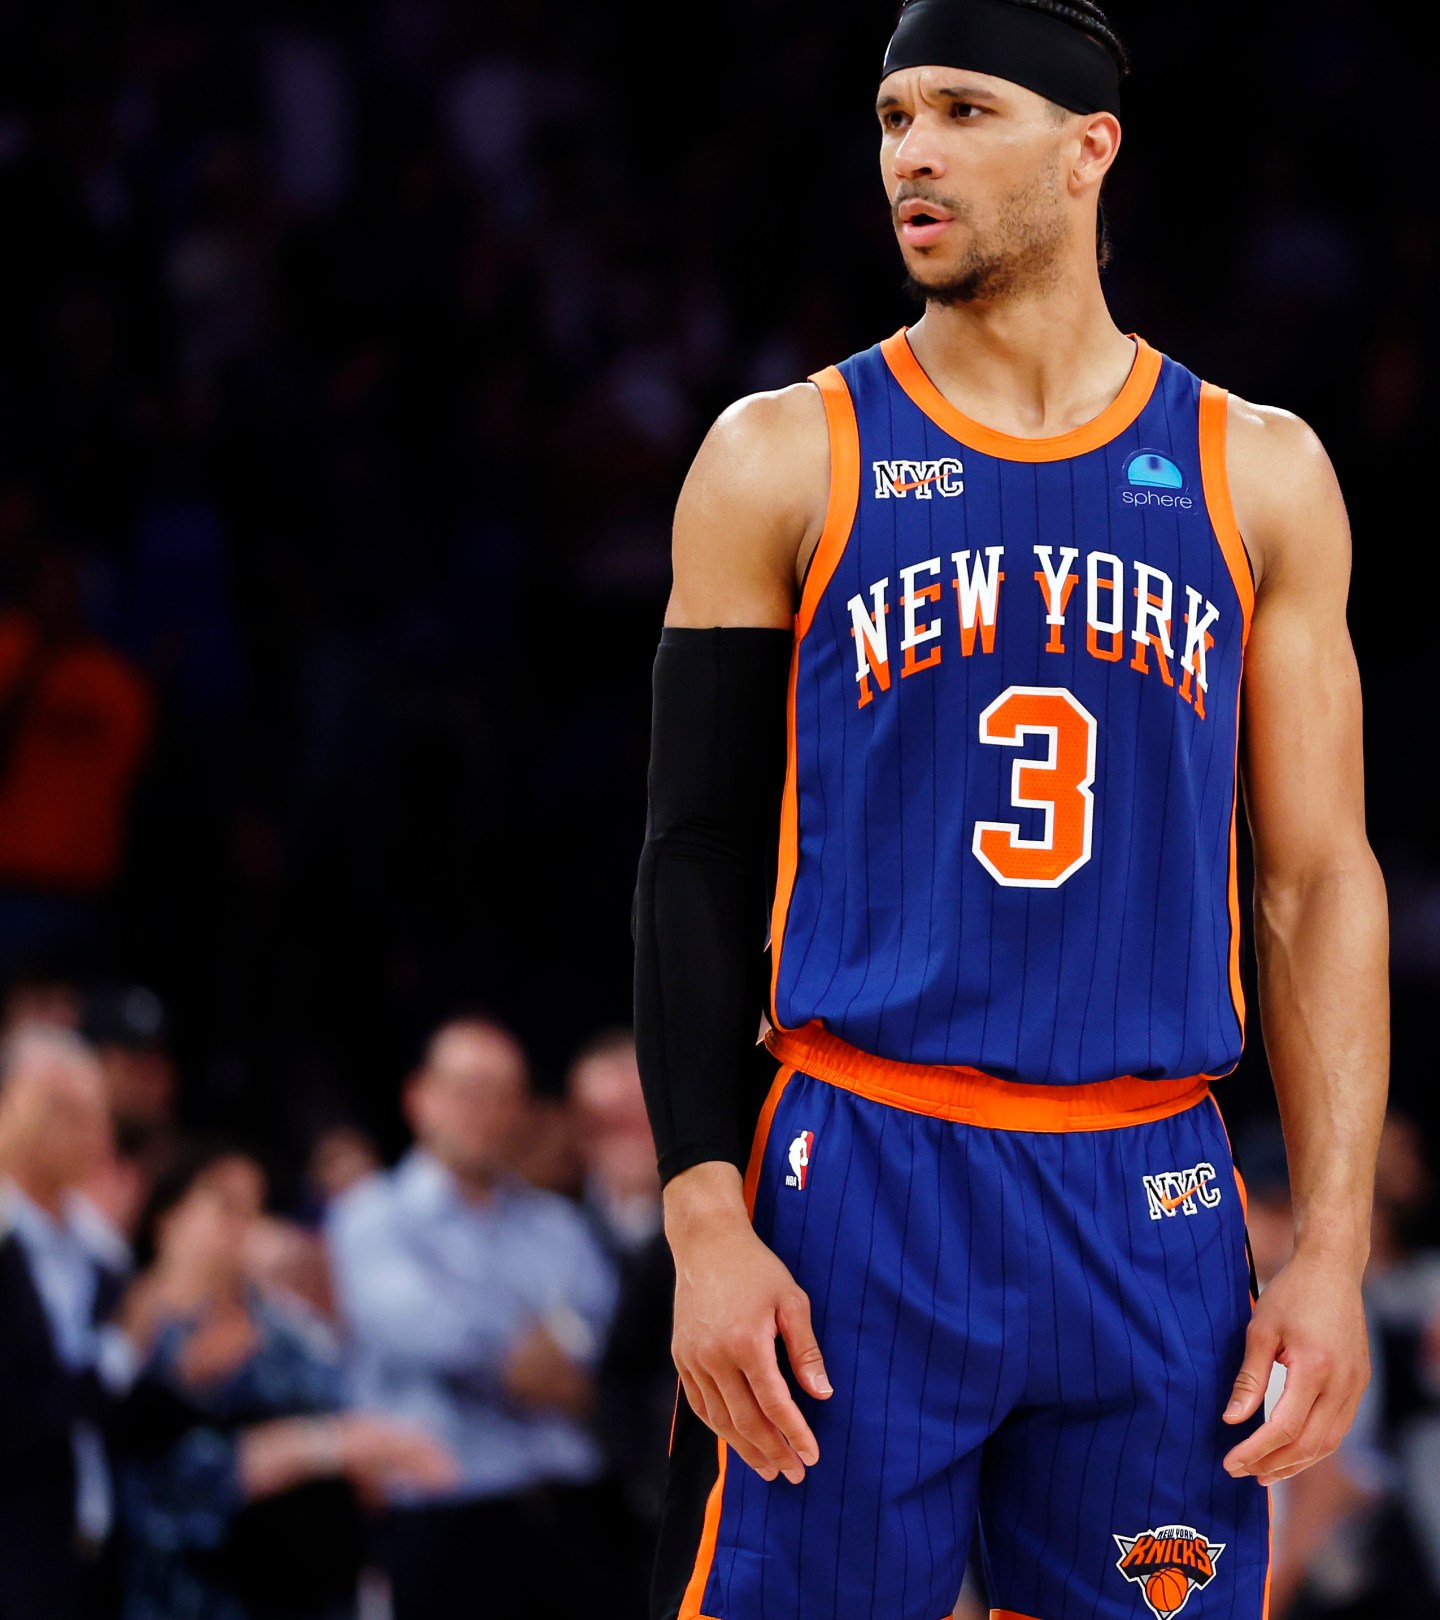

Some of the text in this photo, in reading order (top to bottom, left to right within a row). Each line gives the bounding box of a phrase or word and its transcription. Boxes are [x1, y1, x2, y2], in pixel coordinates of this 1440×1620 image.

[873, 458, 964, 499] NYC
[1122, 490, 1193, 510] sphere
[847, 545, 1221, 693] NEW YORK
[972, 686, 1097, 888] 3
[785, 1175, 797, 1187] NBA
[1142, 1162, 1221, 1220] NYC
[1157, 1528, 1193, 1540] NEW YORK
[1121, 1536, 1213, 1577] KNICKS
